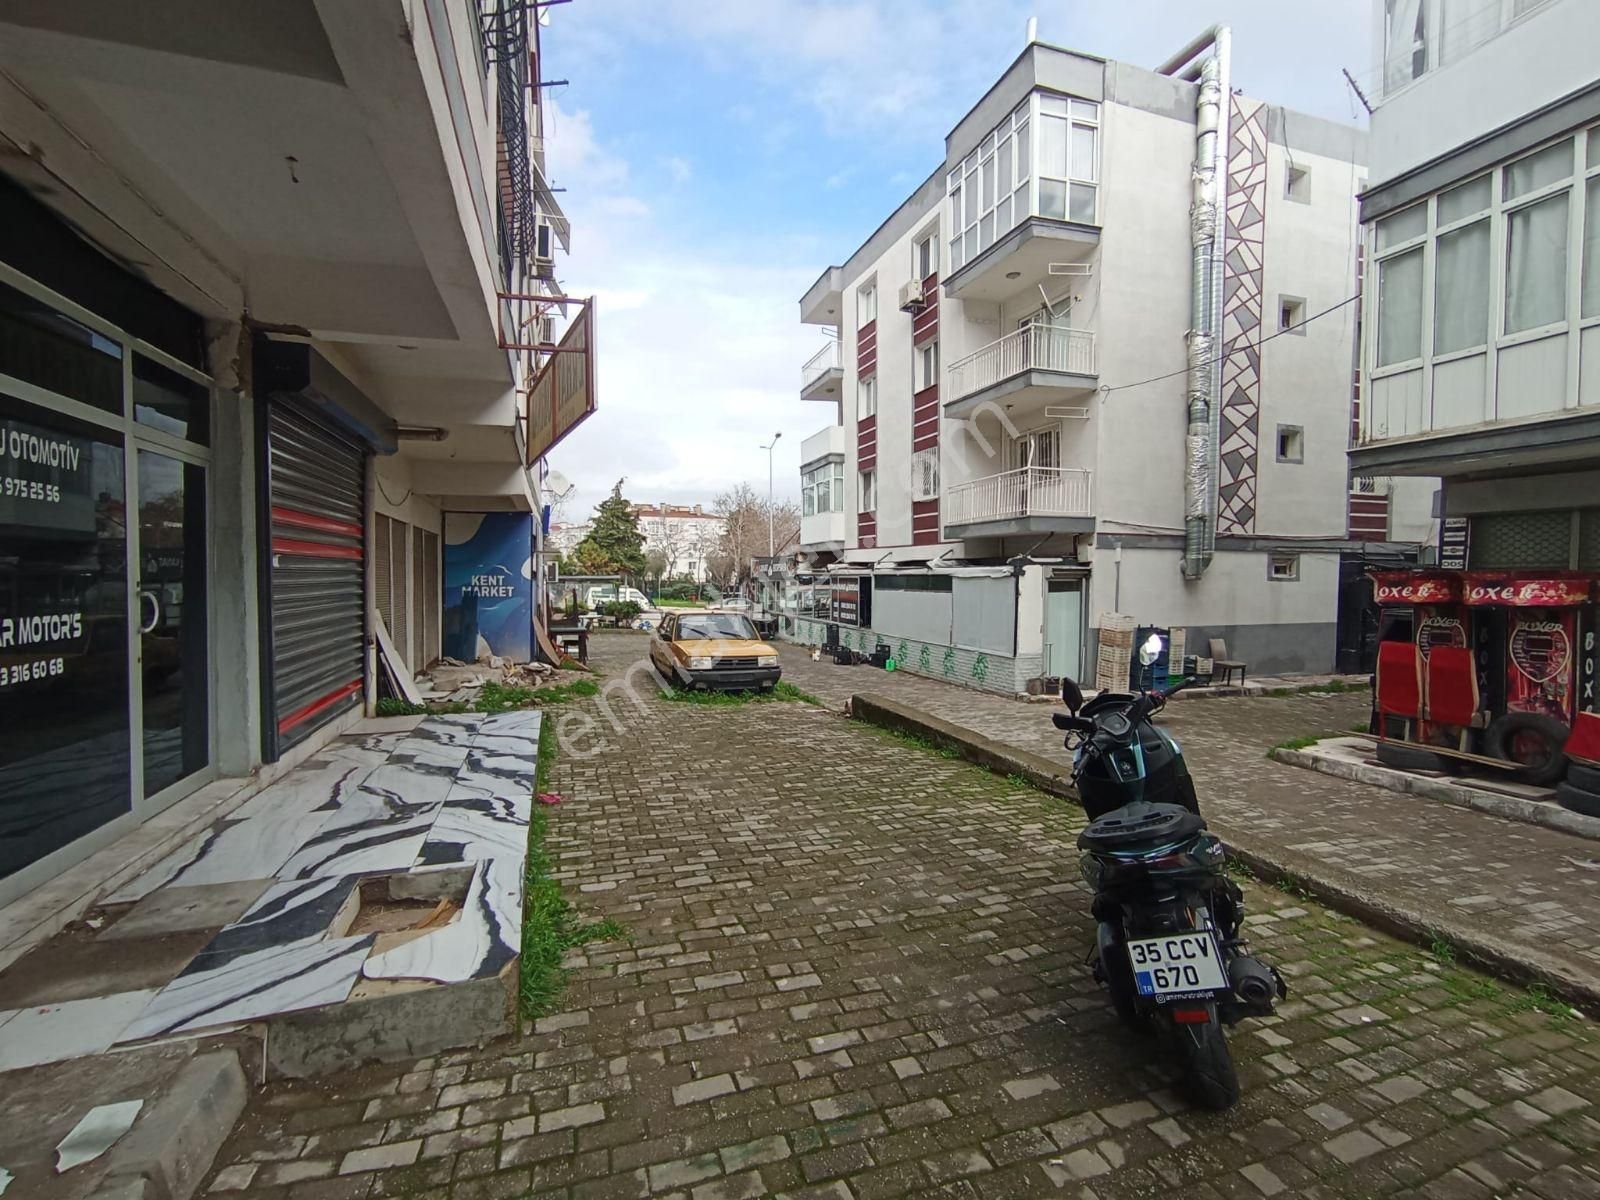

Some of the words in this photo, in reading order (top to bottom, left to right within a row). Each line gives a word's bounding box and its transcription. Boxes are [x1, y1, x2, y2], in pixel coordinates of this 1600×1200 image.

[9, 430, 80, 472] OTOMOTİV
[5, 477, 28, 498] 975
[30, 481, 44, 500] 25
[46, 484, 60, 503] 56
[461, 586, 515, 597] MARKET
[471, 575, 505, 586] KENT
[0, 618, 15, 648] R
[18, 612, 82, 645] MOTOR'S
[11, 664, 30, 684] 316
[32, 660, 47, 679] 60
[49, 657, 64, 676] 68
[1132, 942, 1162, 965] 35
[1165, 937, 1208, 960] CCV
[1143, 985, 1153, 993] TR
[1153, 965, 1200, 988] 670
